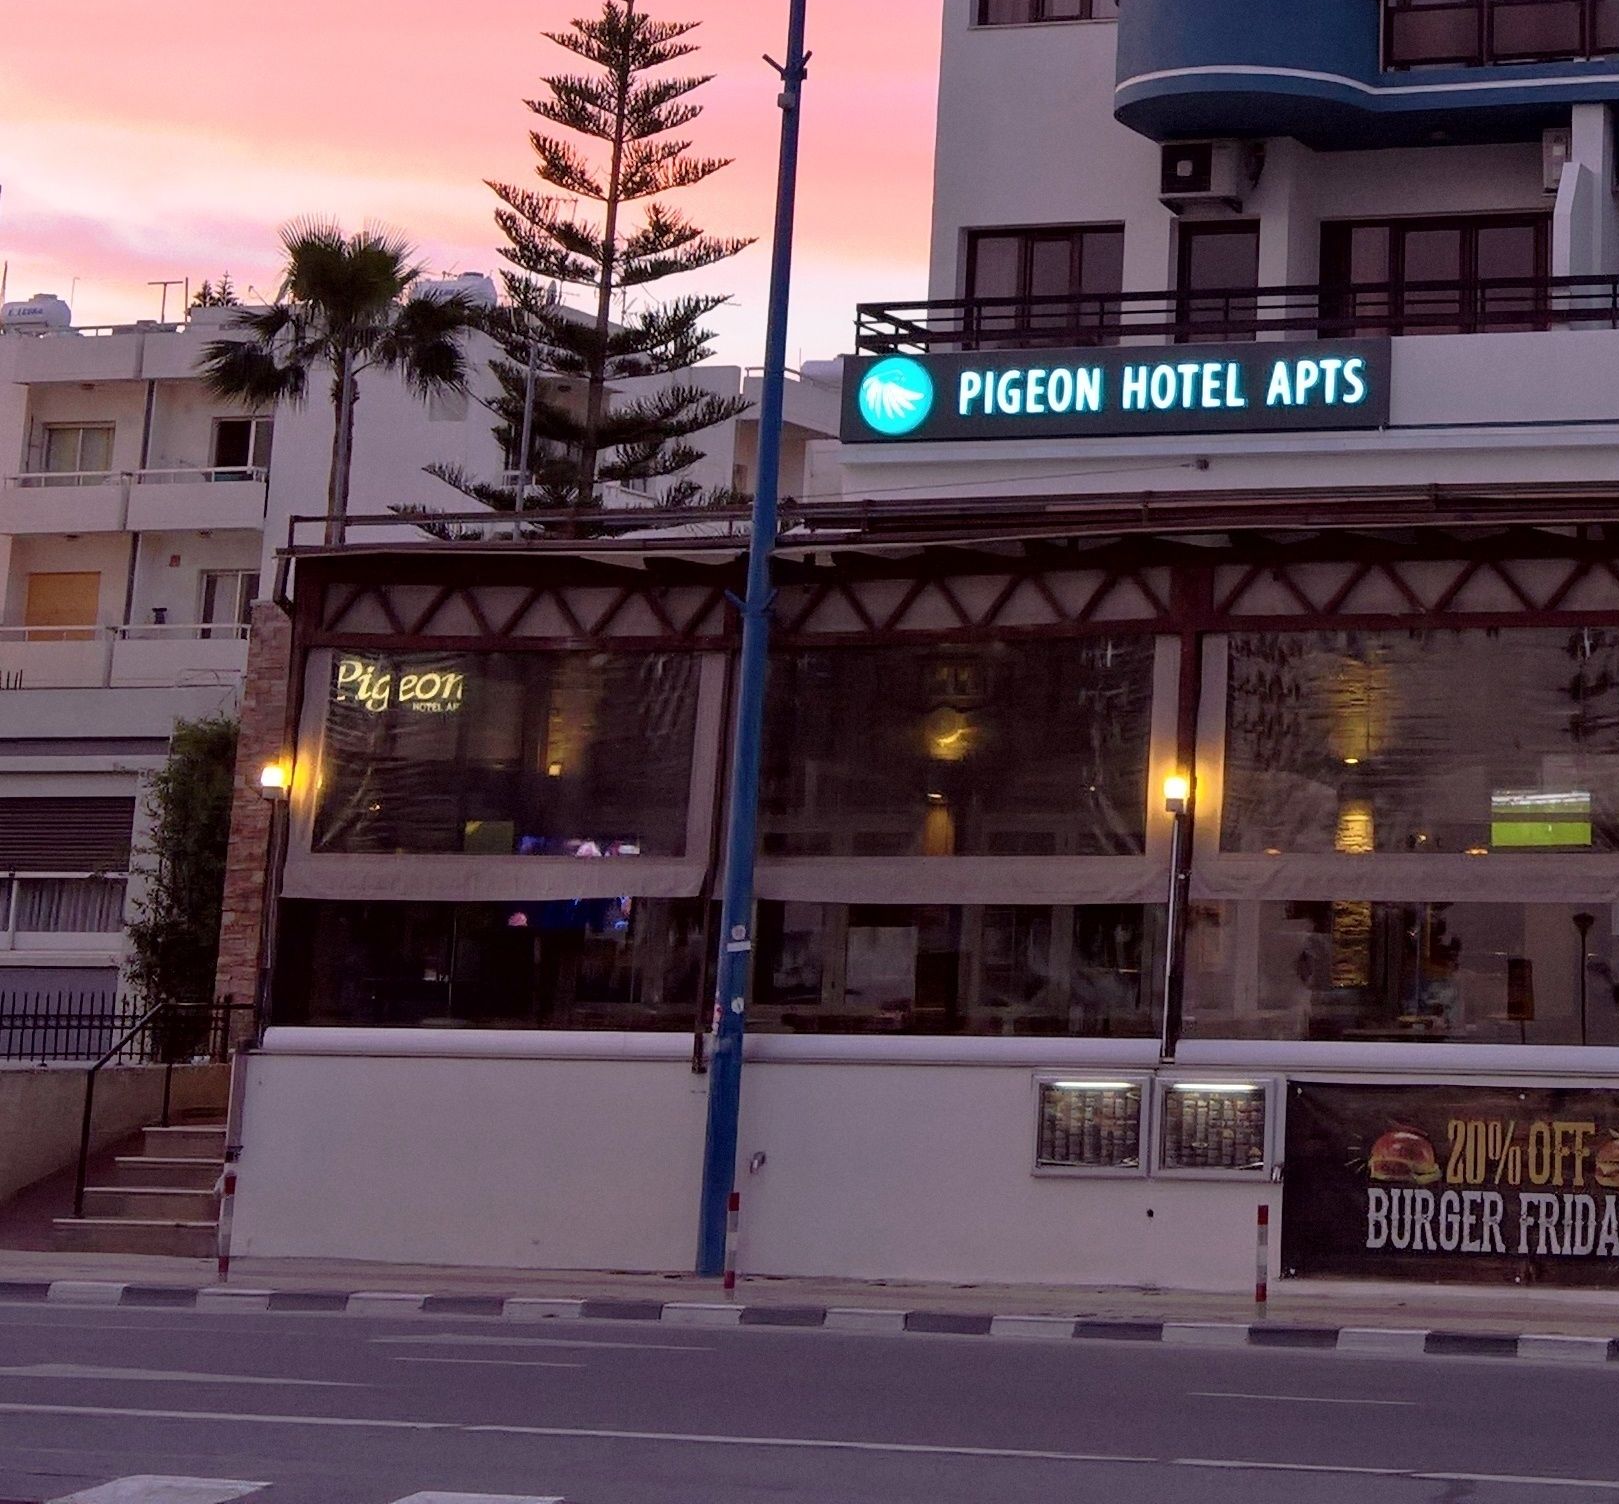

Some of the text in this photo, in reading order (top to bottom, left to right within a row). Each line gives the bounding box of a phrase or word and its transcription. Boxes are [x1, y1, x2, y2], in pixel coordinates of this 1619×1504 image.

[959, 358, 1367, 416] PIGEON HOTEL APTS
[336, 659, 465, 713] Pigeon
[412, 702, 443, 713] HOTEL
[1446, 1119, 1596, 1187] 20% OFF
[1366, 1187, 1506, 1254] BURGER
